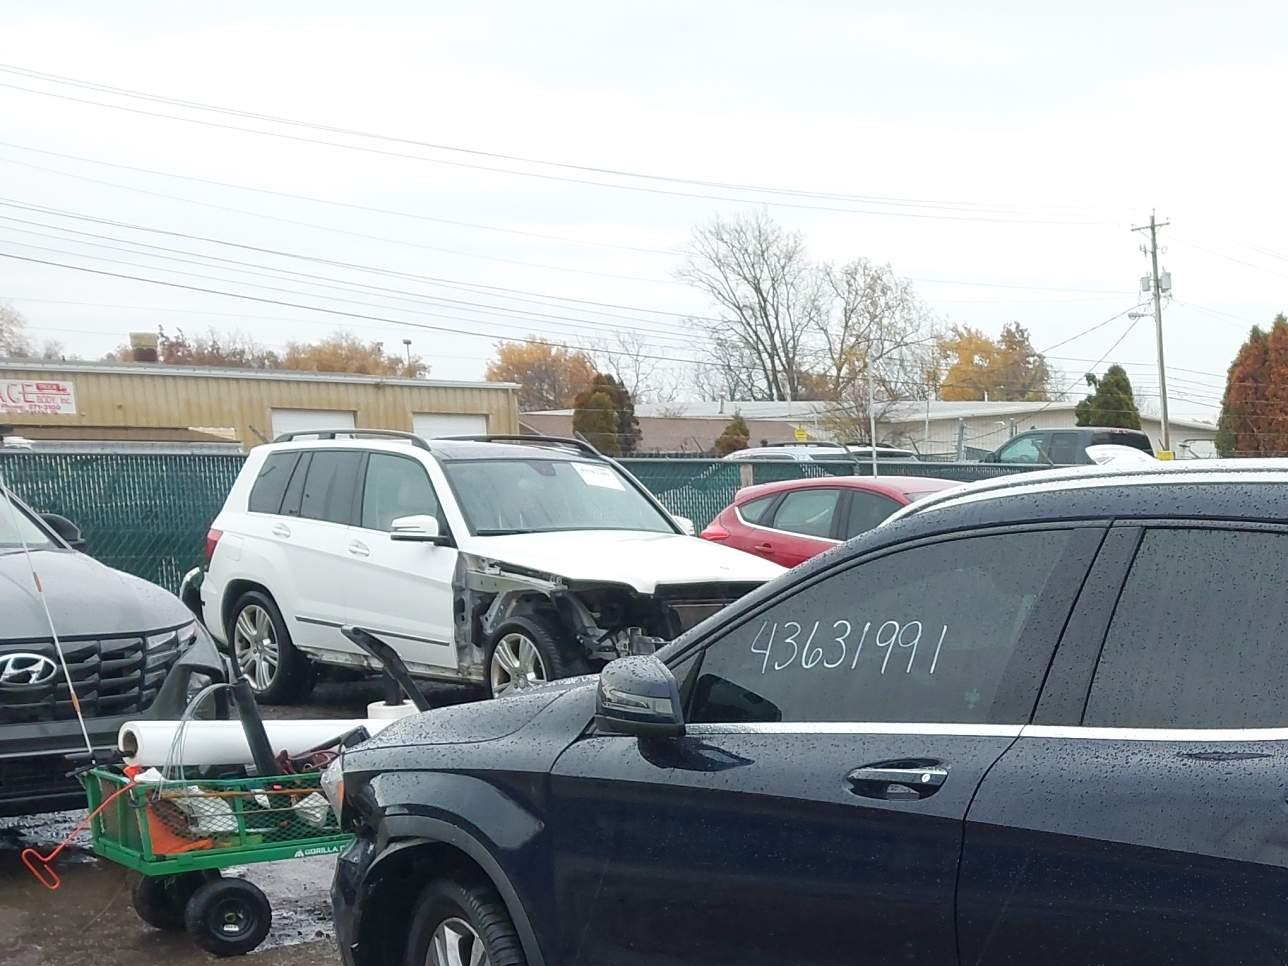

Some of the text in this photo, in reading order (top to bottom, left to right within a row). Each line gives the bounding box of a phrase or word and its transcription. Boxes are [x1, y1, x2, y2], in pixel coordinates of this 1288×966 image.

[0, 383, 34, 403] CE
[751, 620, 948, 674] 43631991
[305, 846, 339, 855] GORILLA
